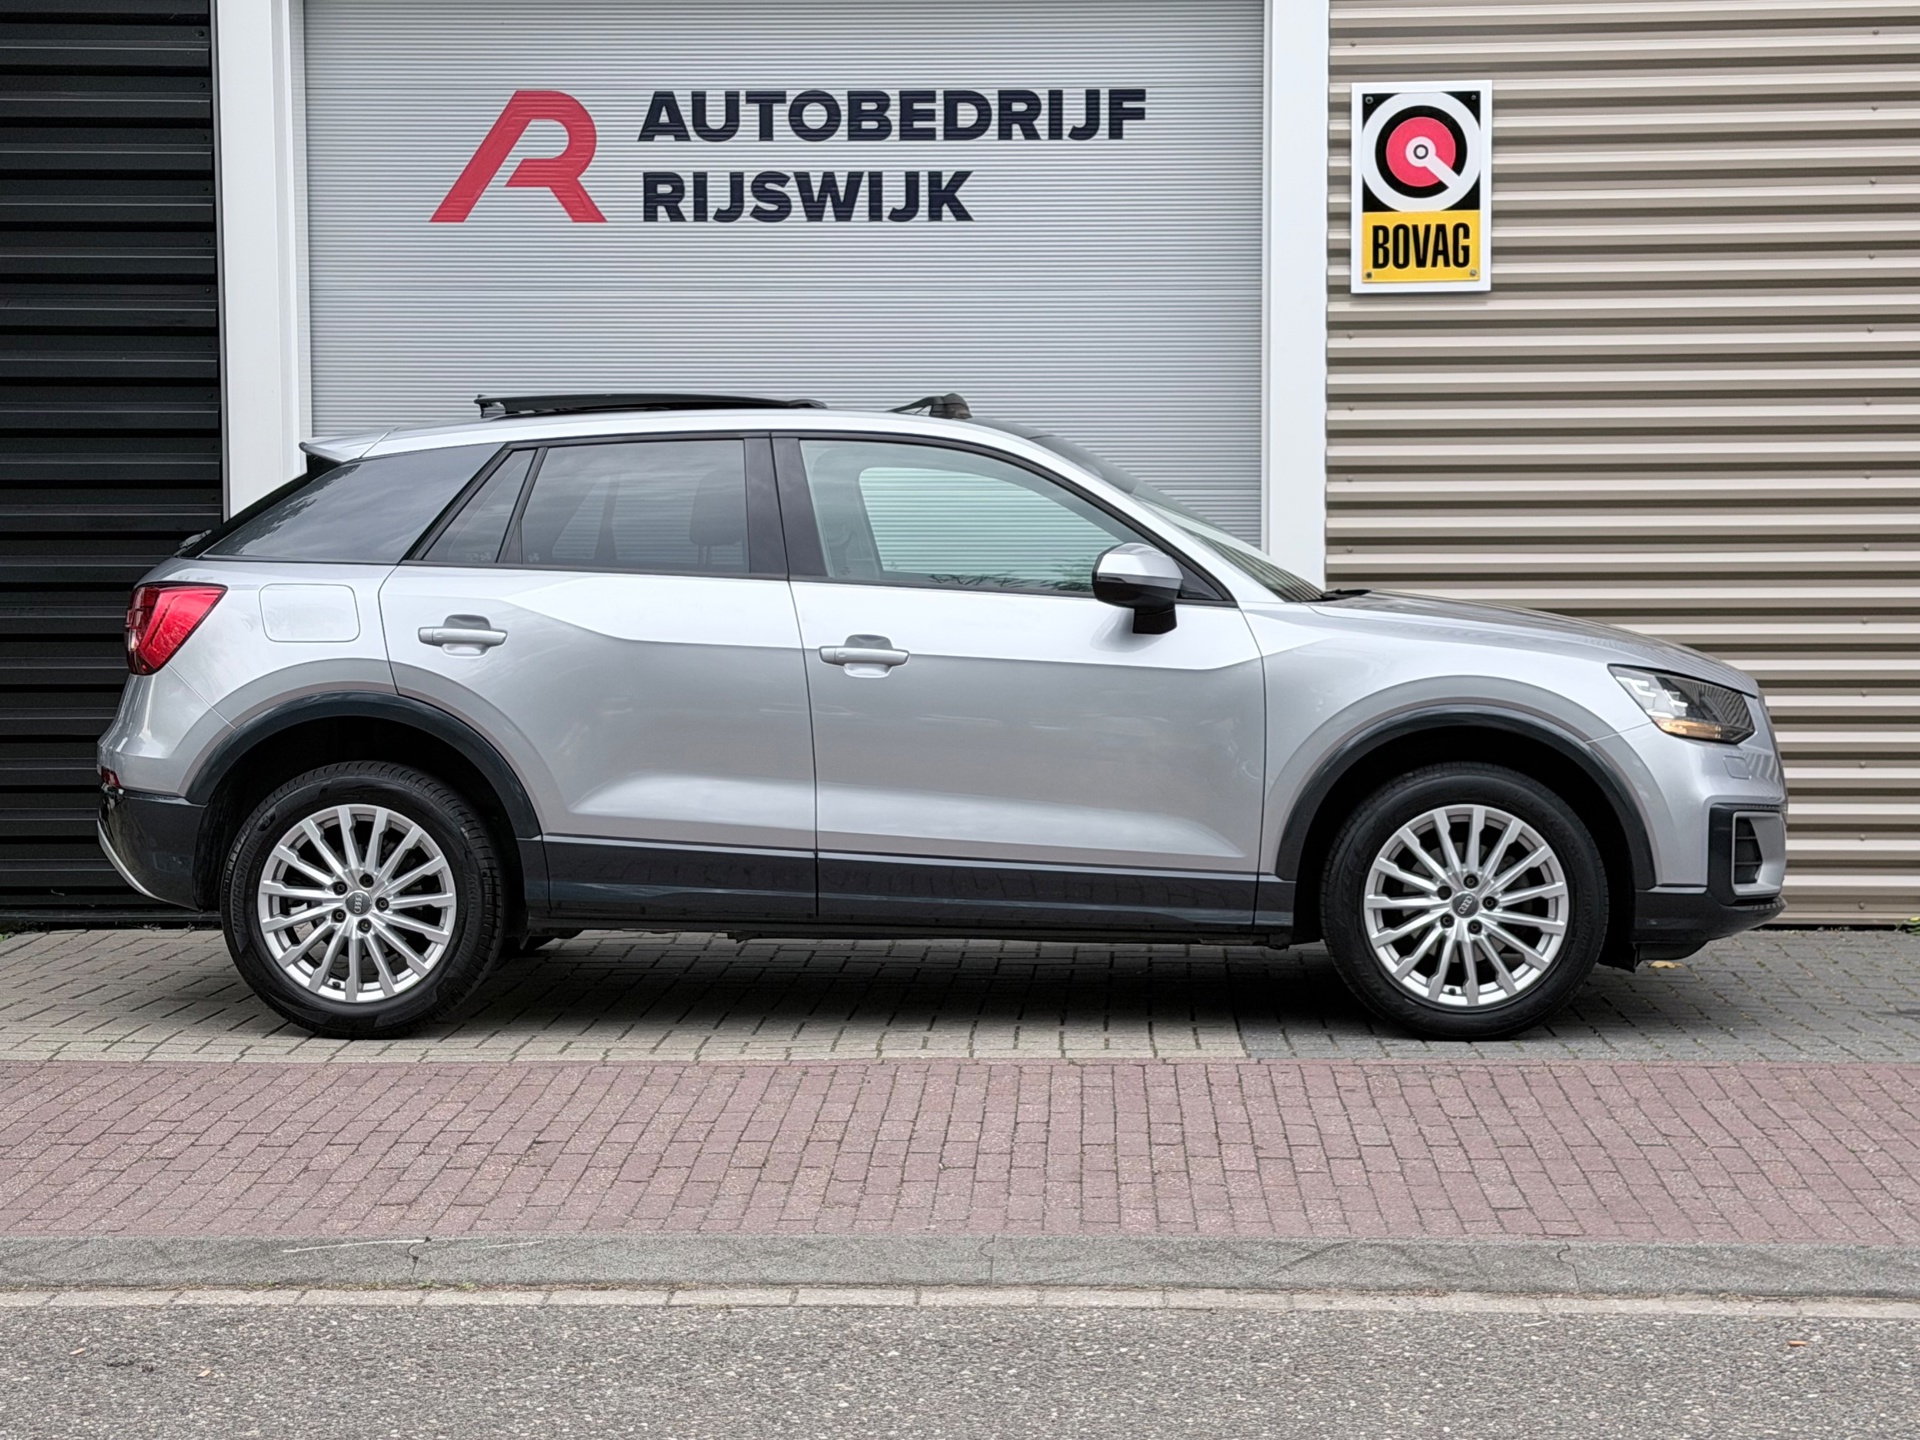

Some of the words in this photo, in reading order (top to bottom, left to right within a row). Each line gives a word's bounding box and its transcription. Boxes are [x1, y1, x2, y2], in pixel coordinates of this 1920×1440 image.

[638, 89, 1146, 142] AUTOBEDRIJF
[643, 171, 974, 222] RIJSWIJK
[1372, 222, 1470, 269] BOVAG
